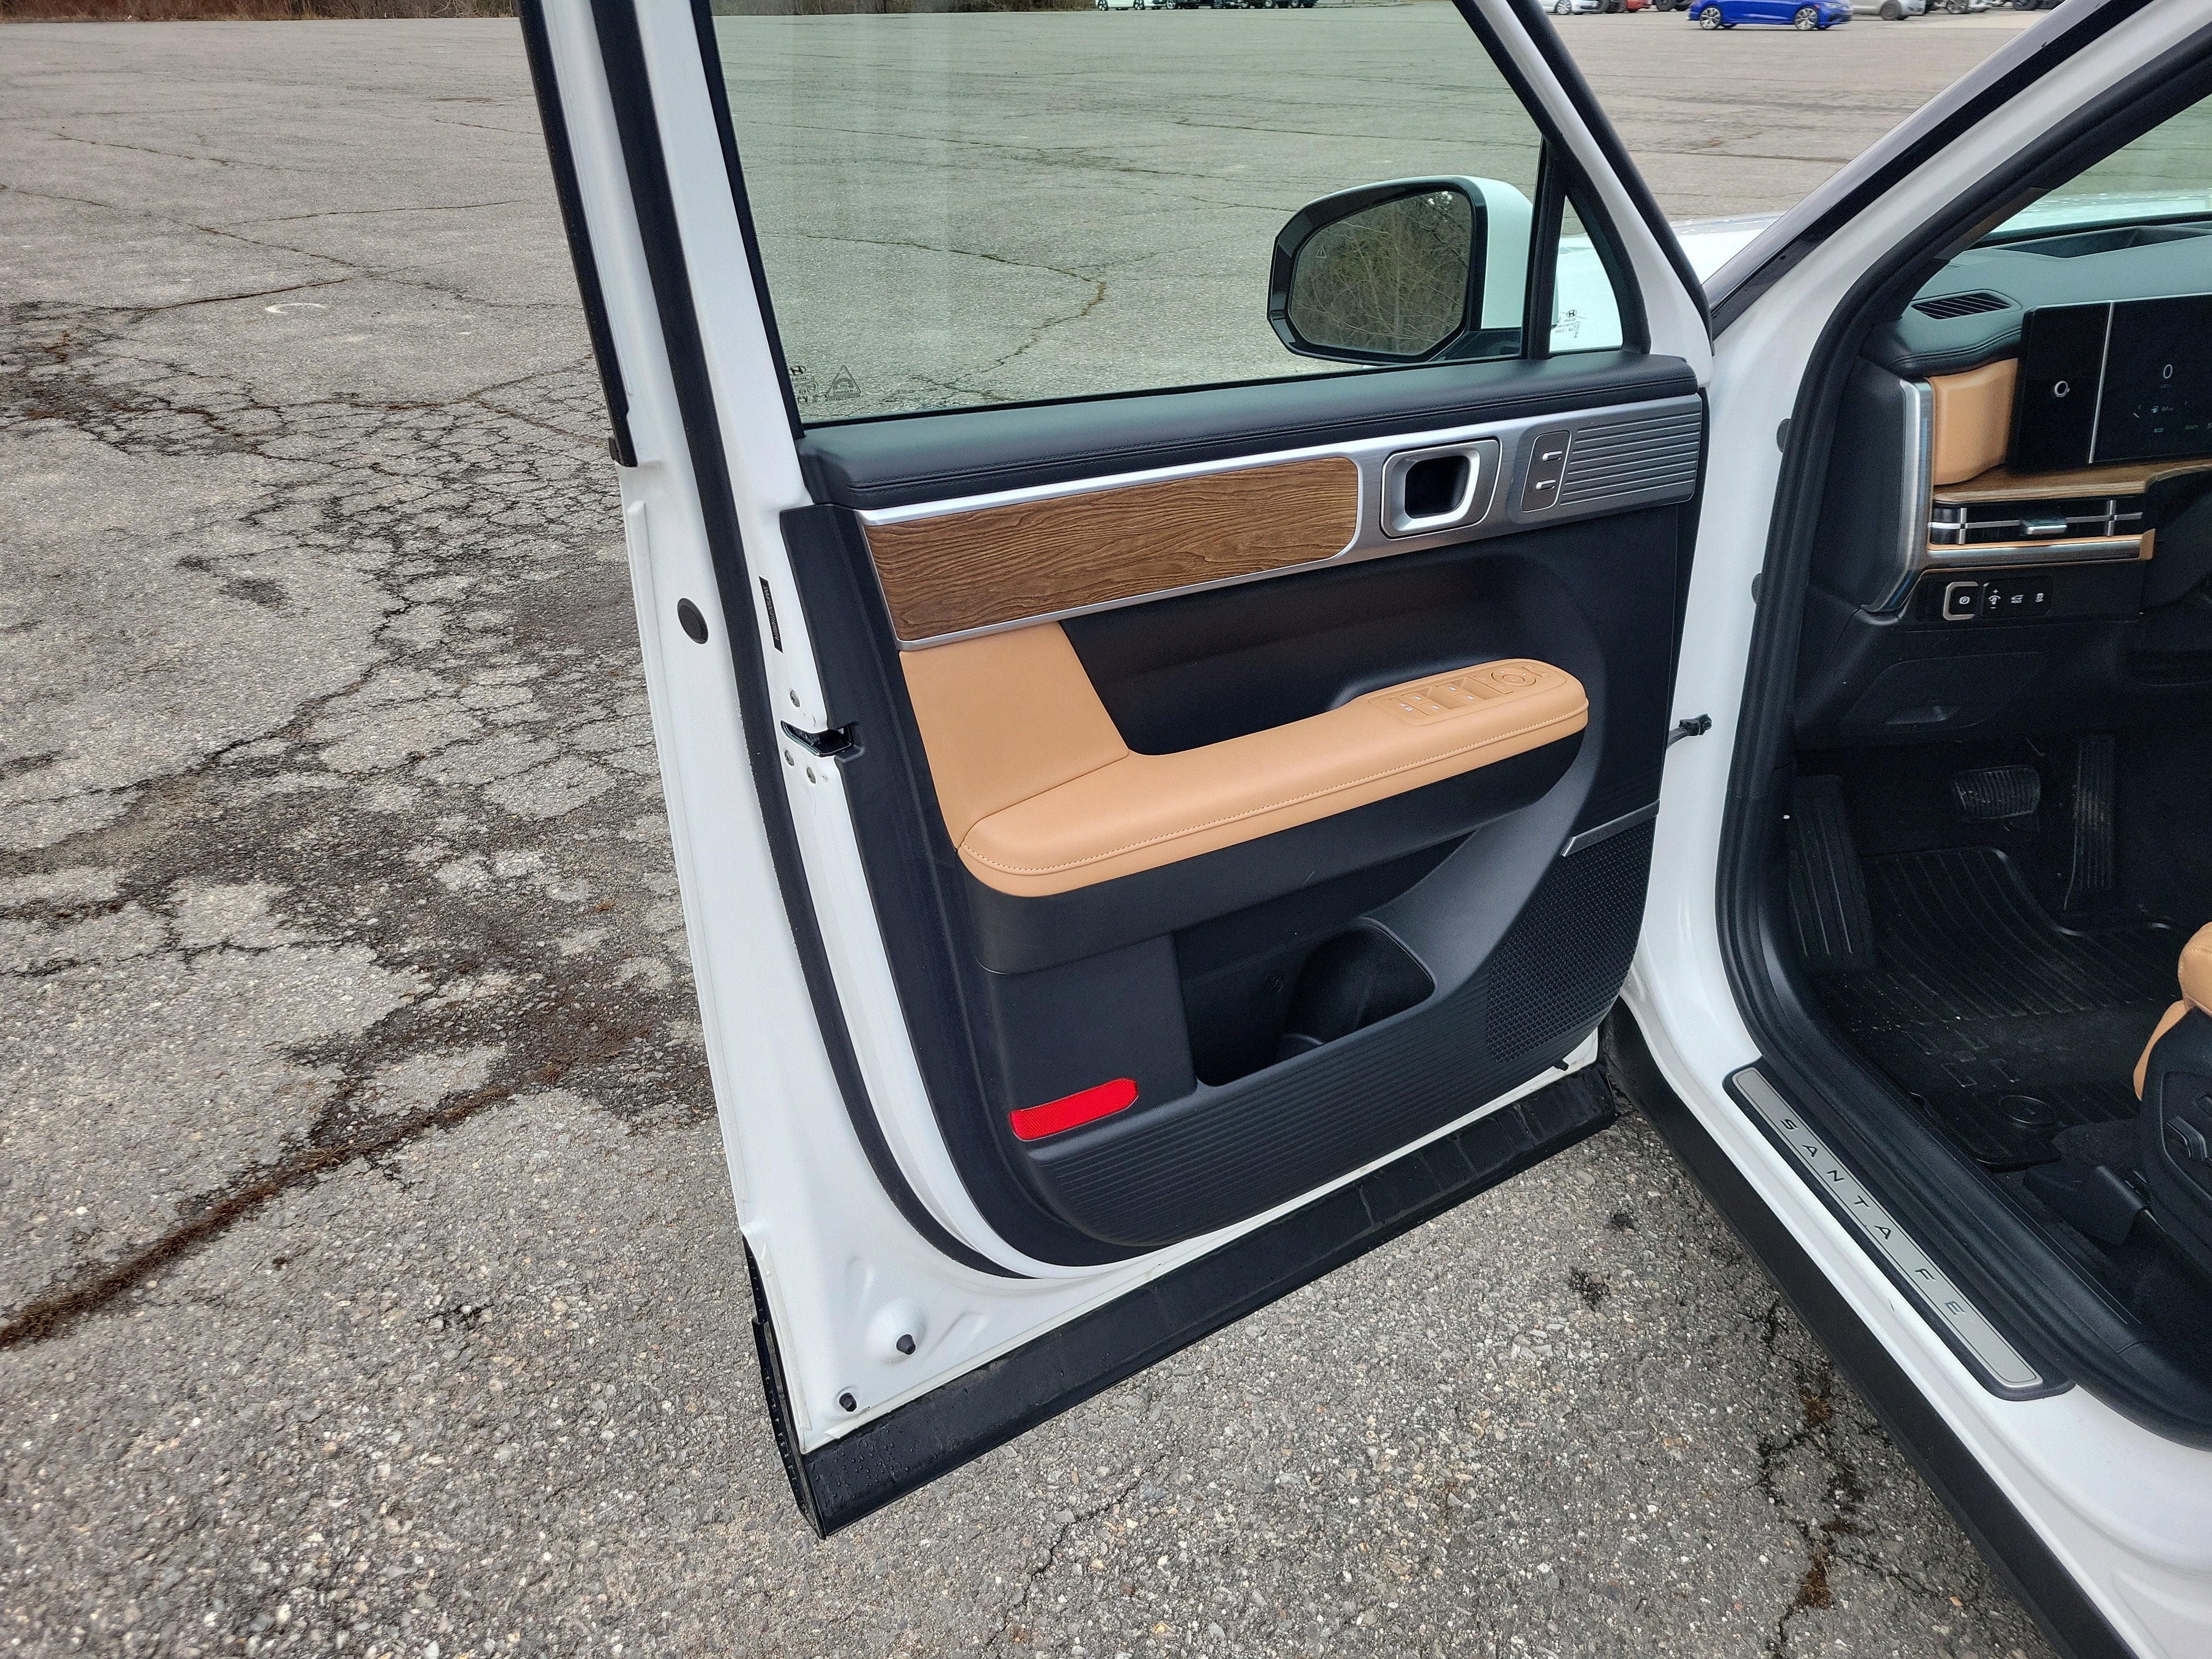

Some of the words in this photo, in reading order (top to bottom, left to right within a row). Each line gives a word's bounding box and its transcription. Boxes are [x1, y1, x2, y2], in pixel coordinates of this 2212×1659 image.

[2163, 364, 2173, 379] 0
[1780, 1119, 1892, 1240] SANTA
[1915, 1268, 1966, 1316] FE
